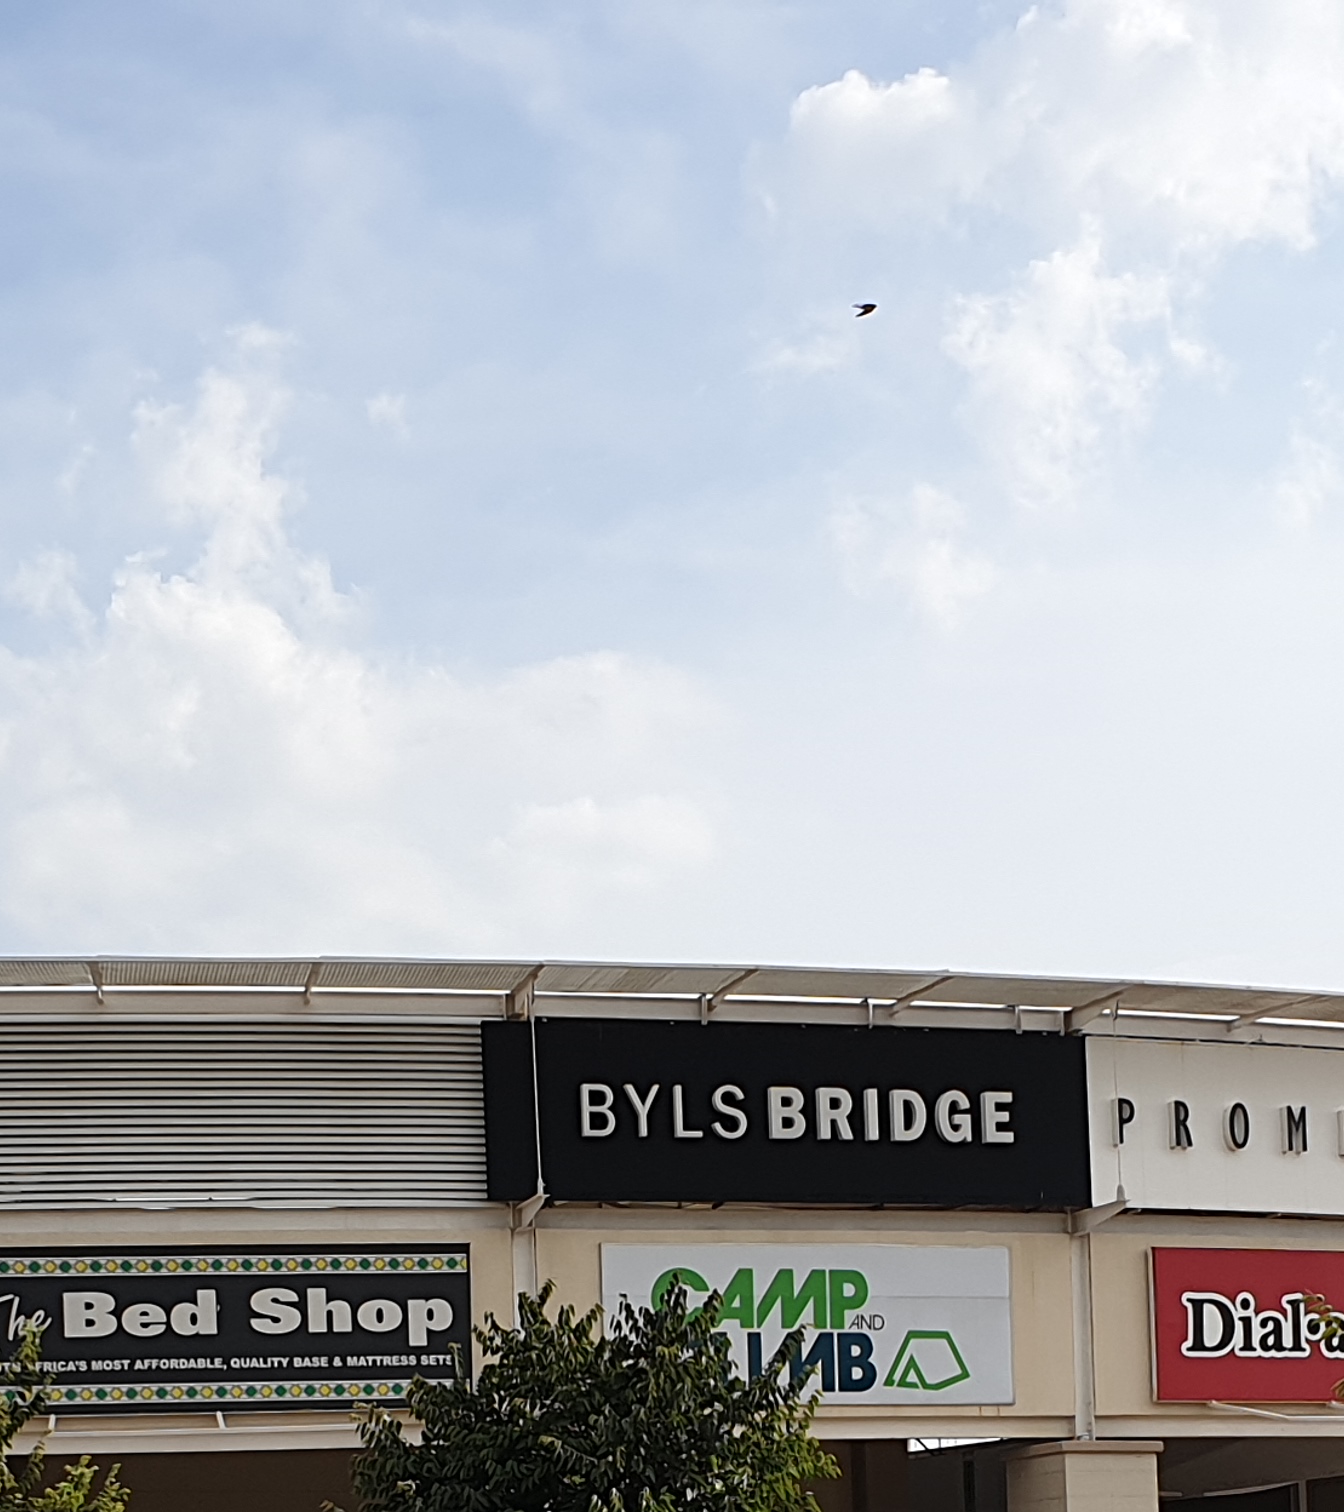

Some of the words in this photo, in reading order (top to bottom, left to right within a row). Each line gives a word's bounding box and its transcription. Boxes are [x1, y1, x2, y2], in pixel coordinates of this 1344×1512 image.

[579, 1082, 748, 1140] BYLS
[767, 1086, 1015, 1144] BRIDGE
[62, 1289, 218, 1338] Bed
[249, 1287, 454, 1346] Shop
[650, 1267, 869, 1330] CAMP
[848, 1314, 885, 1331] AND
[29, 1359, 88, 1373] FRICA'S
[91, 1359, 131, 1371] MOST
[134, 1357, 228, 1370] AFFORDABLE,
[230, 1357, 290, 1369] QUALITY
[293, 1356, 329, 1368] BASE
[333, 1356, 343, 1367] &
[346, 1355, 417, 1367] MATTRESS
[688, 1331, 878, 1393] IMB
